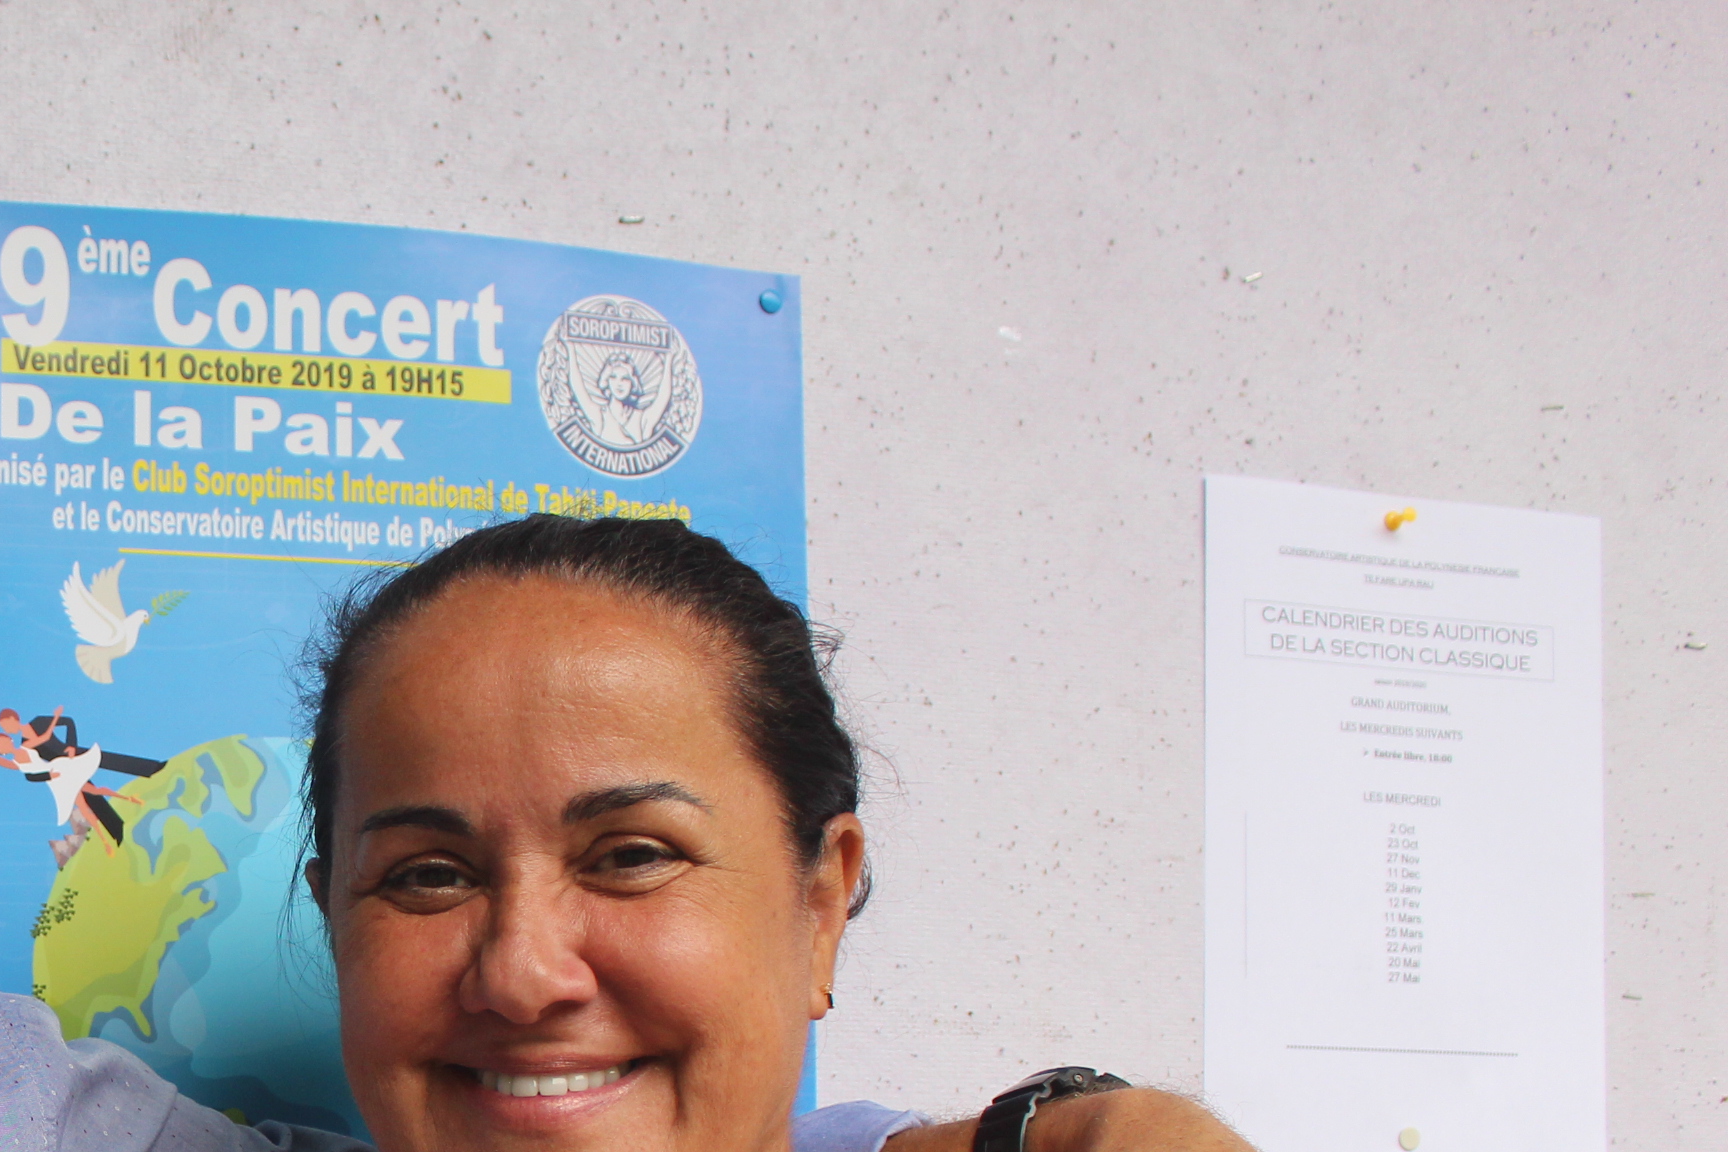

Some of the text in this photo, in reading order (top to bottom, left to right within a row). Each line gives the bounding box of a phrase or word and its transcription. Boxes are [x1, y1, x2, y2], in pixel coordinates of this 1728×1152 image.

[152, 257, 505, 368] Concert
[569, 316, 670, 347] SOROPTIMIST
[13, 344, 465, 397] Vendredi 11 Octobre 2019 à 19H15
[0, 382, 406, 461] De la Paix
[563, 424, 680, 474] INTERNATIONAL
[54, 462, 97, 496] par
[102, 457, 125, 491] le
[132, 459, 188, 494] Club
[194, 462, 336, 506] Soroptimist
[342, 470, 494, 512] International
[500, 480, 530, 514] de
[52, 501, 75, 531] et
[80, 500, 101, 532] le
[105, 500, 265, 540] Conservatoire
[270, 508, 381, 552] Artistique
[386, 514, 415, 548] de
[1262, 604, 1539, 648] CALENDRIER DES AUDITIONS
[1270, 632, 1532, 673] DE LA SECTION CLASSIQUE
[1351, 696, 1385, 710] GRAND
[1339, 720, 1465, 742] LES MERCREDIS SUIVANTS
[1363, 790, 1441, 808] LES MERCREDI
[1390, 823, 1416, 835] 2 Oct
[1401, 838, 1419, 850] Oct
[1401, 853, 1421, 865] Nov
[1401, 868, 1421, 880] Dec
[1400, 883, 1423, 895] Janv
[1399, 928, 1423, 939] Mars
[1403, 957, 1421, 969] Mai
[1403, 972, 1421, 984] Mai
